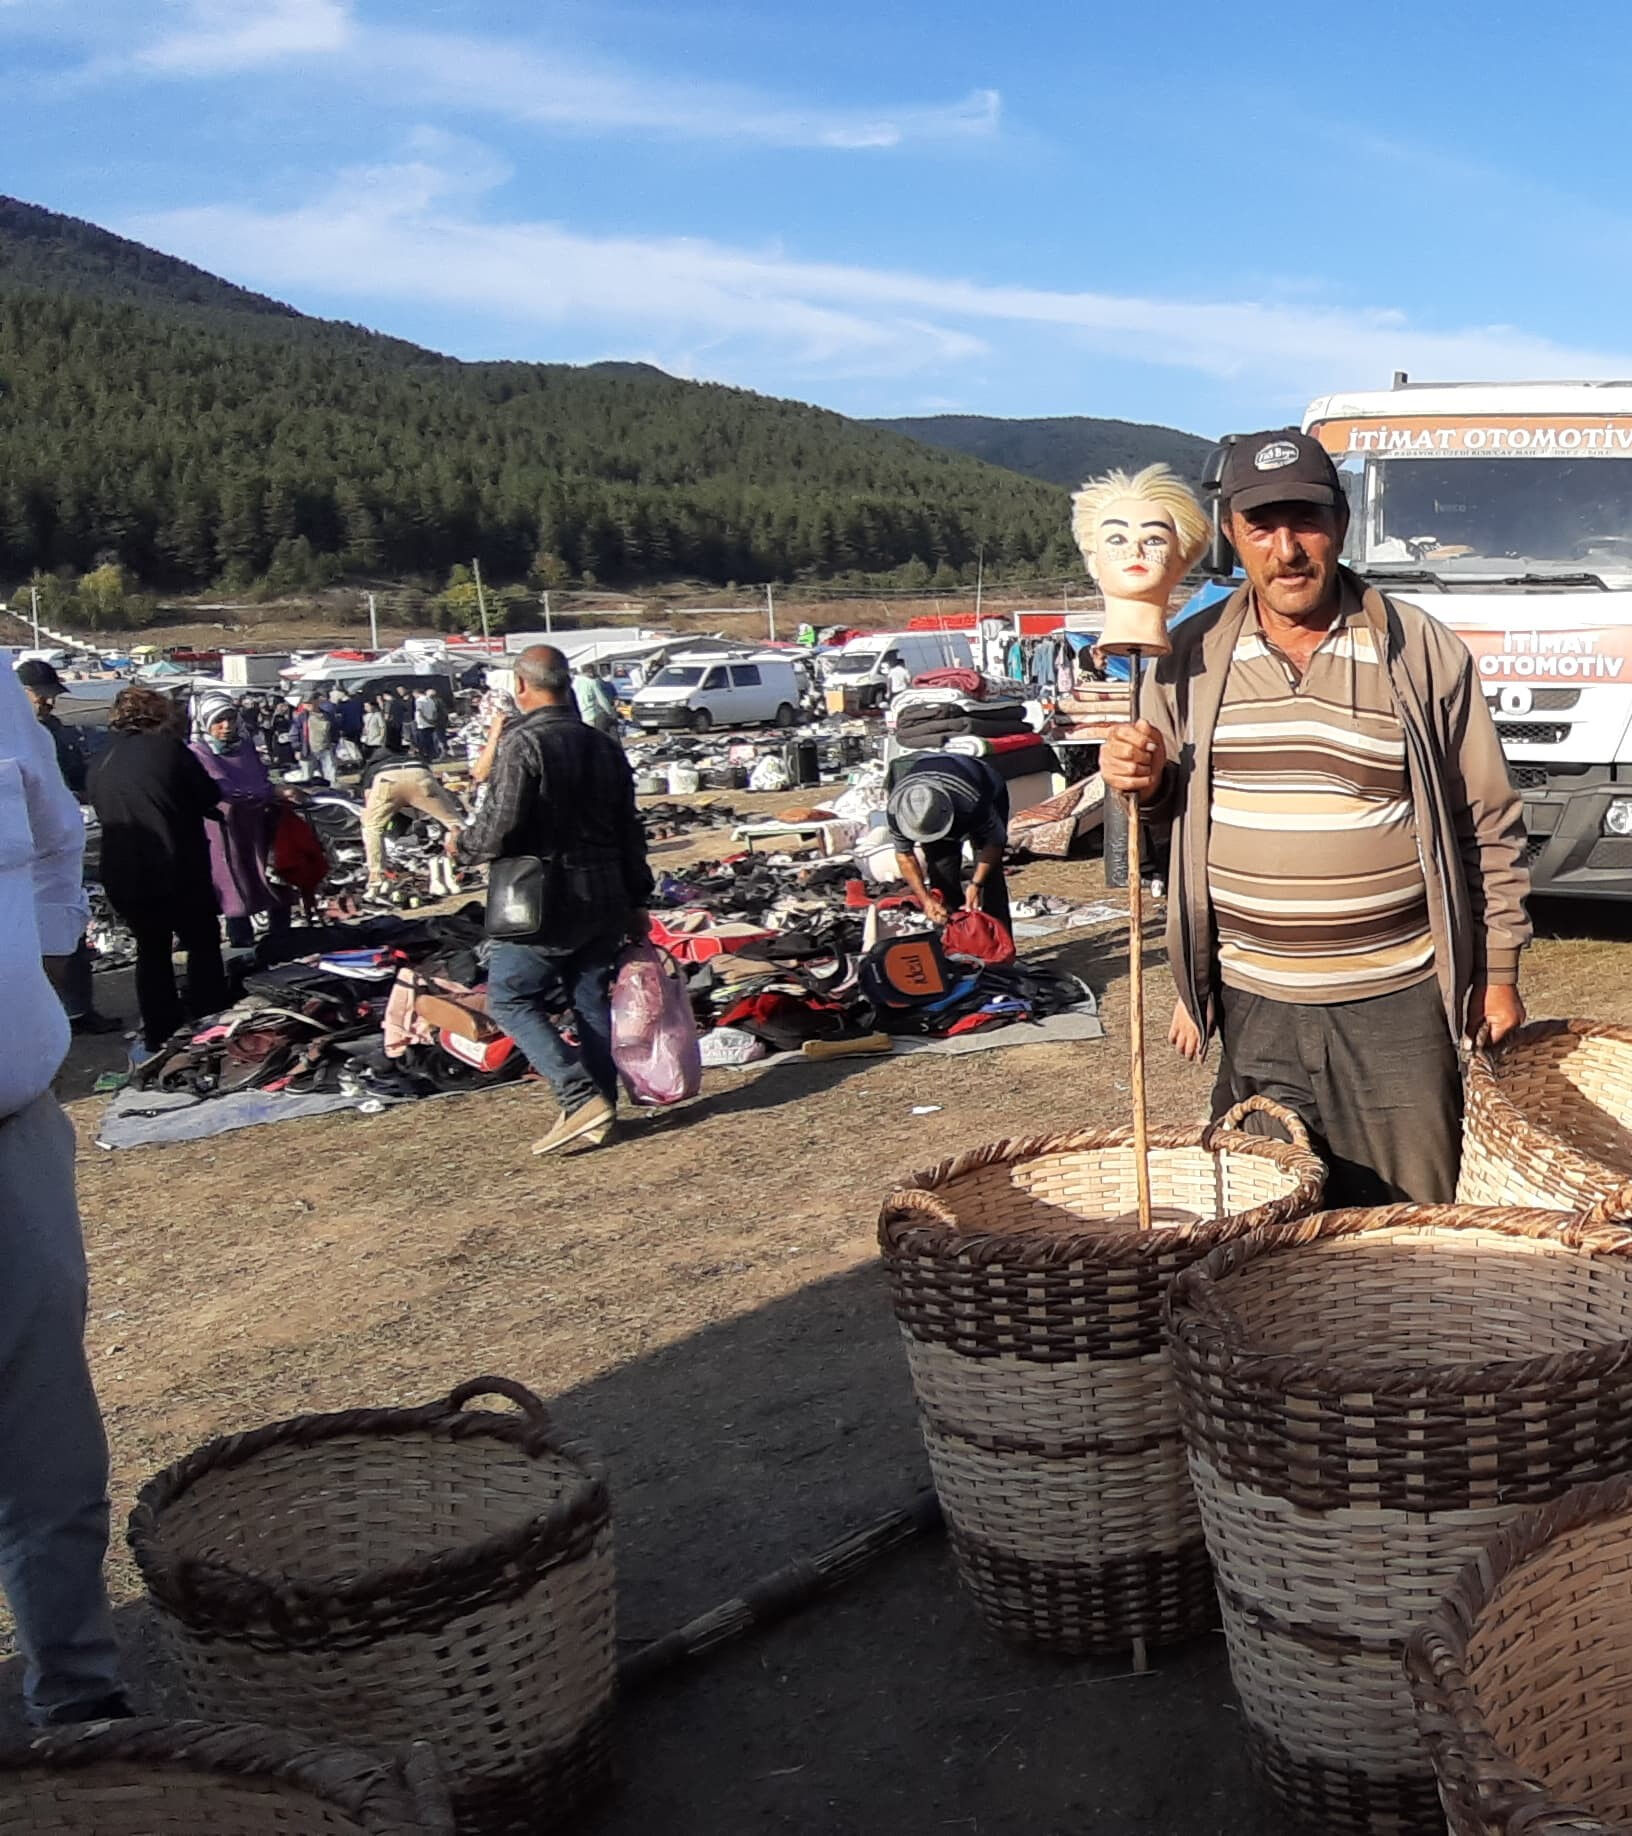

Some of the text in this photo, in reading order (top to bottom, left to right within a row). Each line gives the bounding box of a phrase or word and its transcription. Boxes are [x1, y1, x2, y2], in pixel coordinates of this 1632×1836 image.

[1348, 425, 1457, 451] İTİMAT
[1503, 630, 1599, 654] İTİMAT
[1479, 653, 1625, 677] OTOMOTİV
